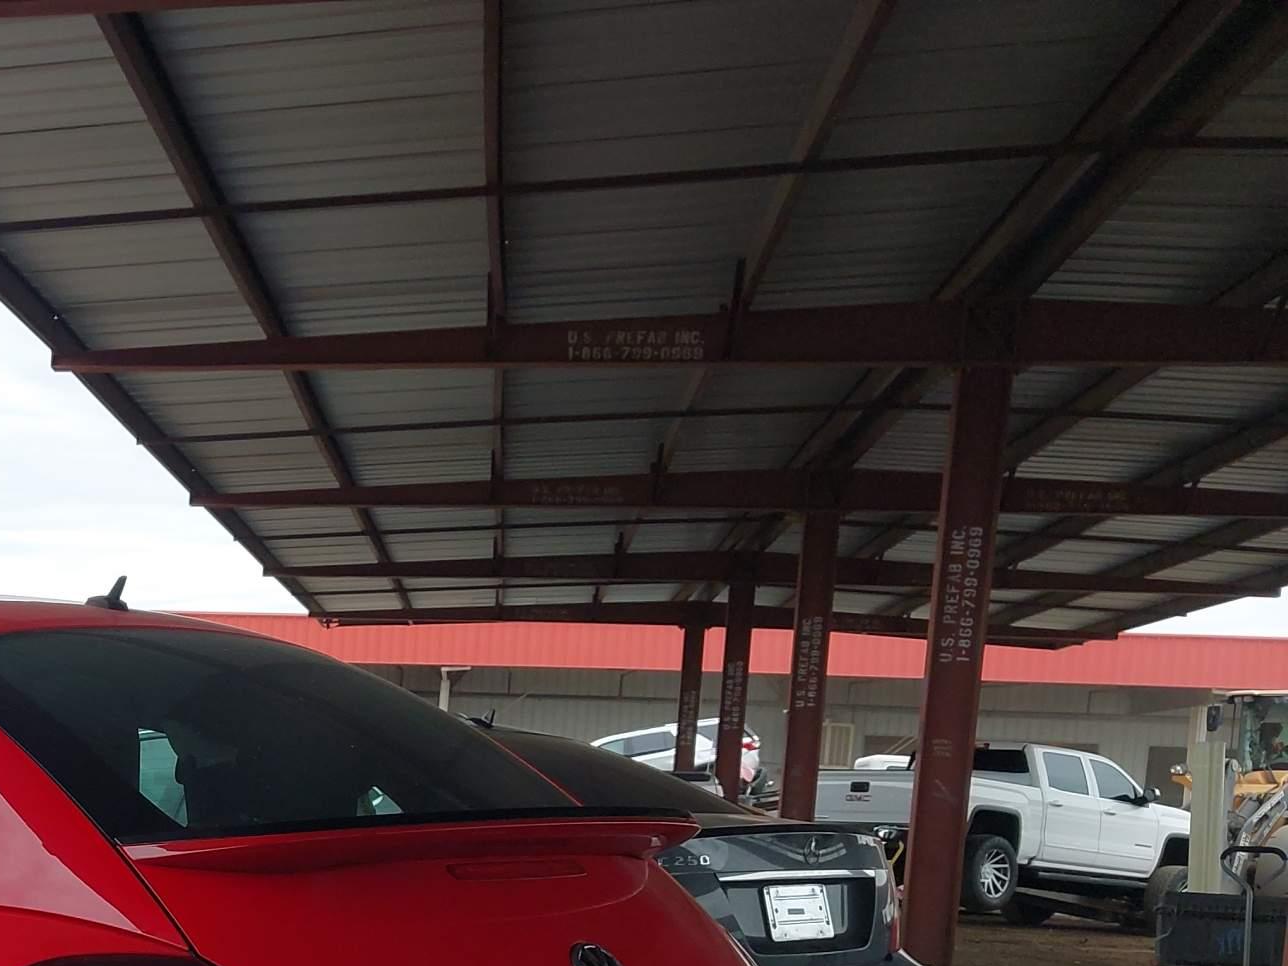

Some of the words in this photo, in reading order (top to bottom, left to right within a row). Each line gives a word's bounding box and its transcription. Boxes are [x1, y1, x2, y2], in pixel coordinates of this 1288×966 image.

[948, 525, 967, 556] INC.
[942, 563, 963, 624] PREFAB
[955, 526, 984, 663] 1-866-799-0969
[938, 633, 956, 663] U.S.
[844, 793, 872, 802] GMC
[673, 854, 711, 867] 250
